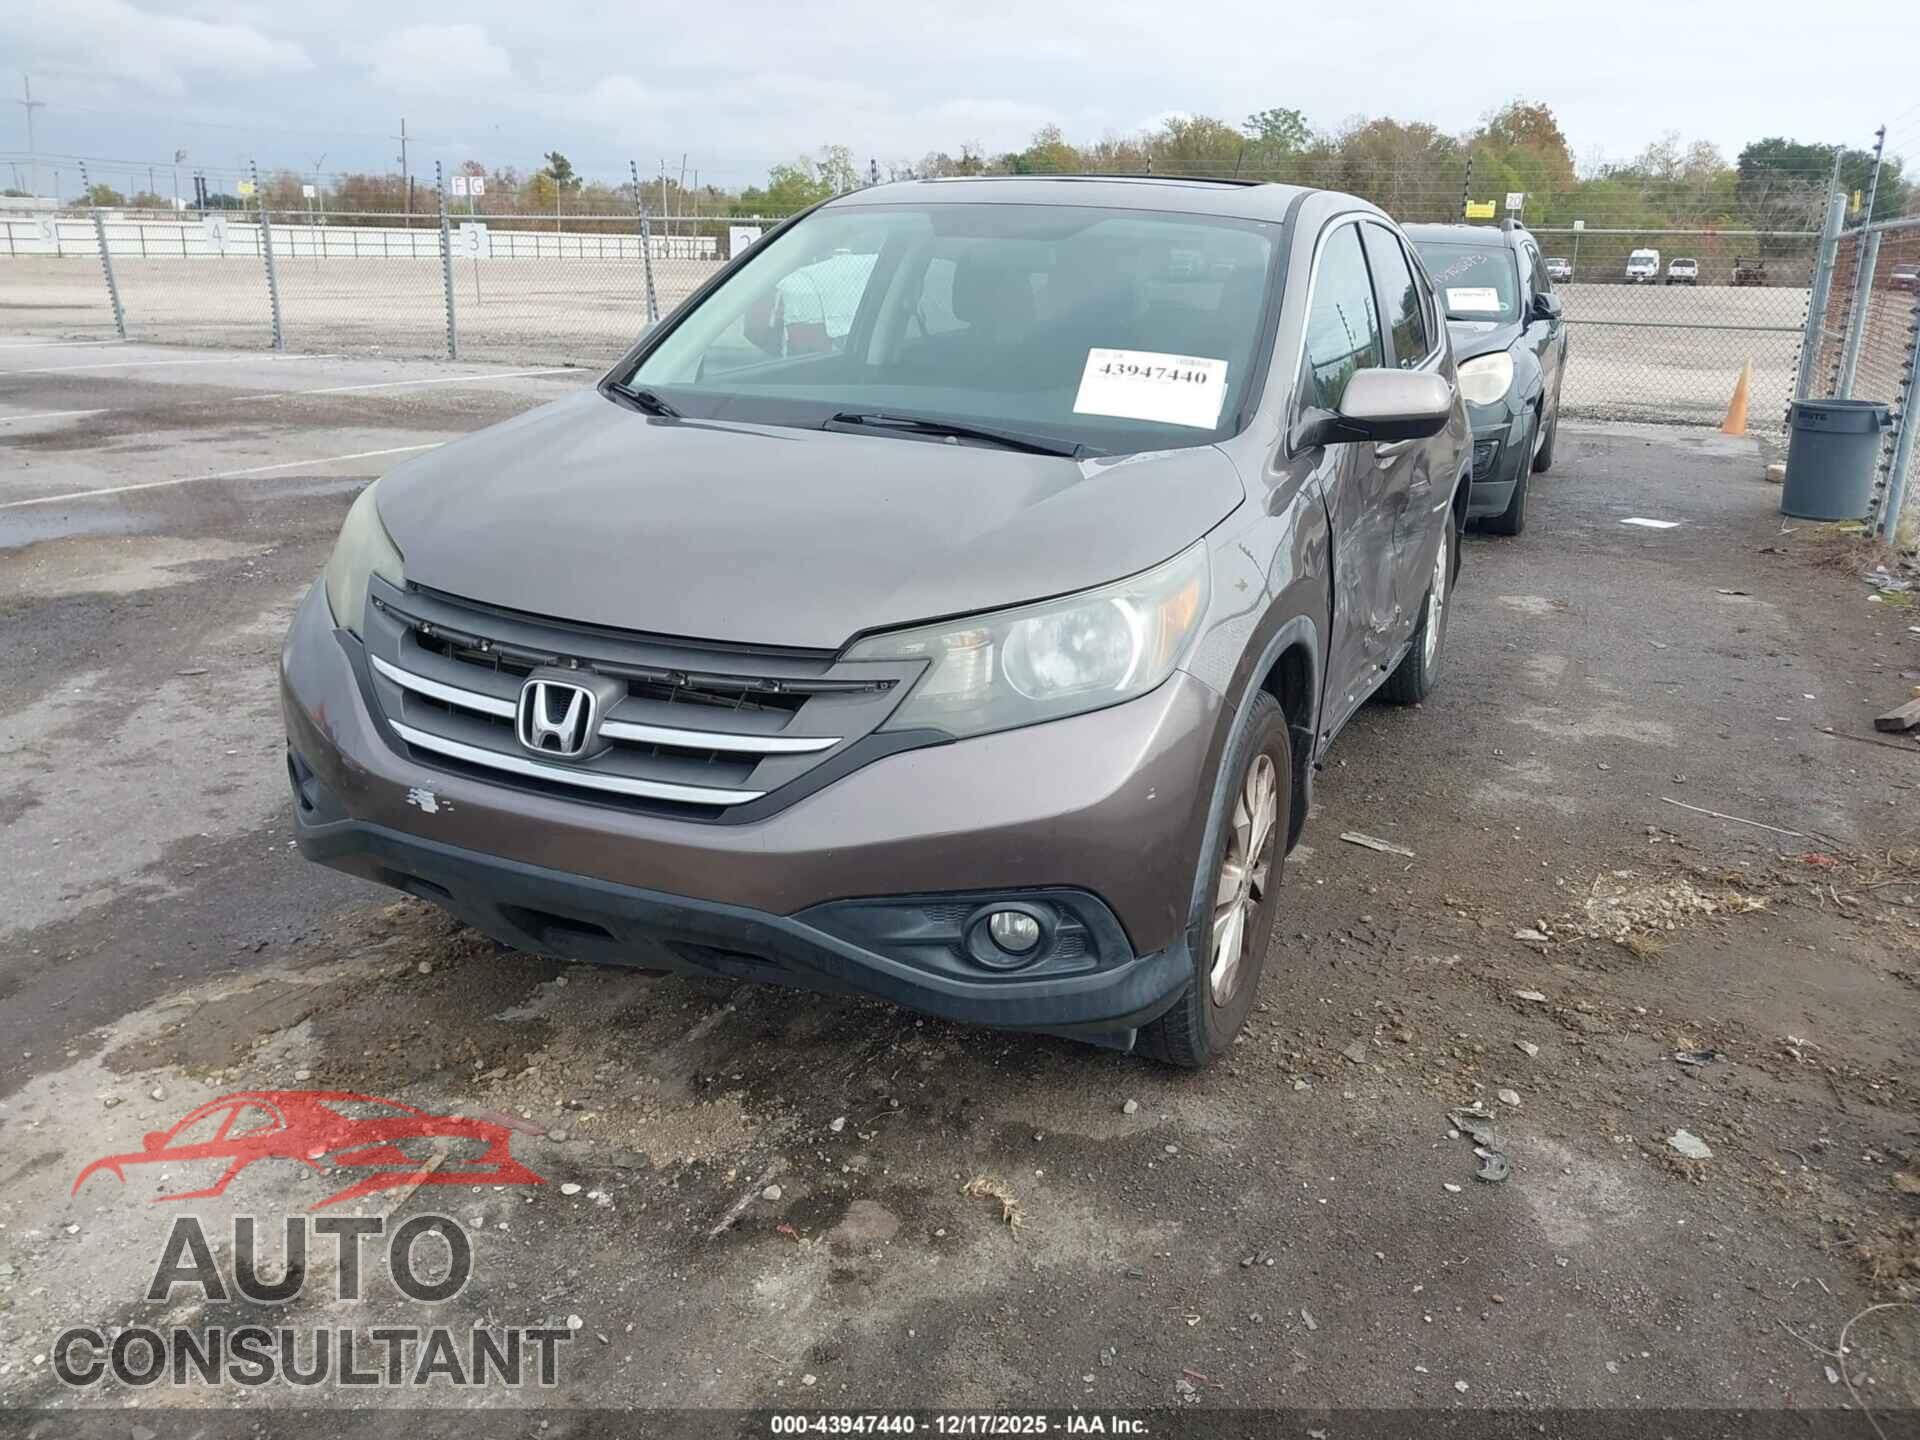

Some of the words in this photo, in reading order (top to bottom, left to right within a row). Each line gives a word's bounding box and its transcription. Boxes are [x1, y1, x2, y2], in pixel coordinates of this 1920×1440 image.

[471, 178, 481, 194] G
[212, 223, 223, 247] 4
[469, 230, 479, 251] 3
[1099, 363, 1207, 384] 43947440
